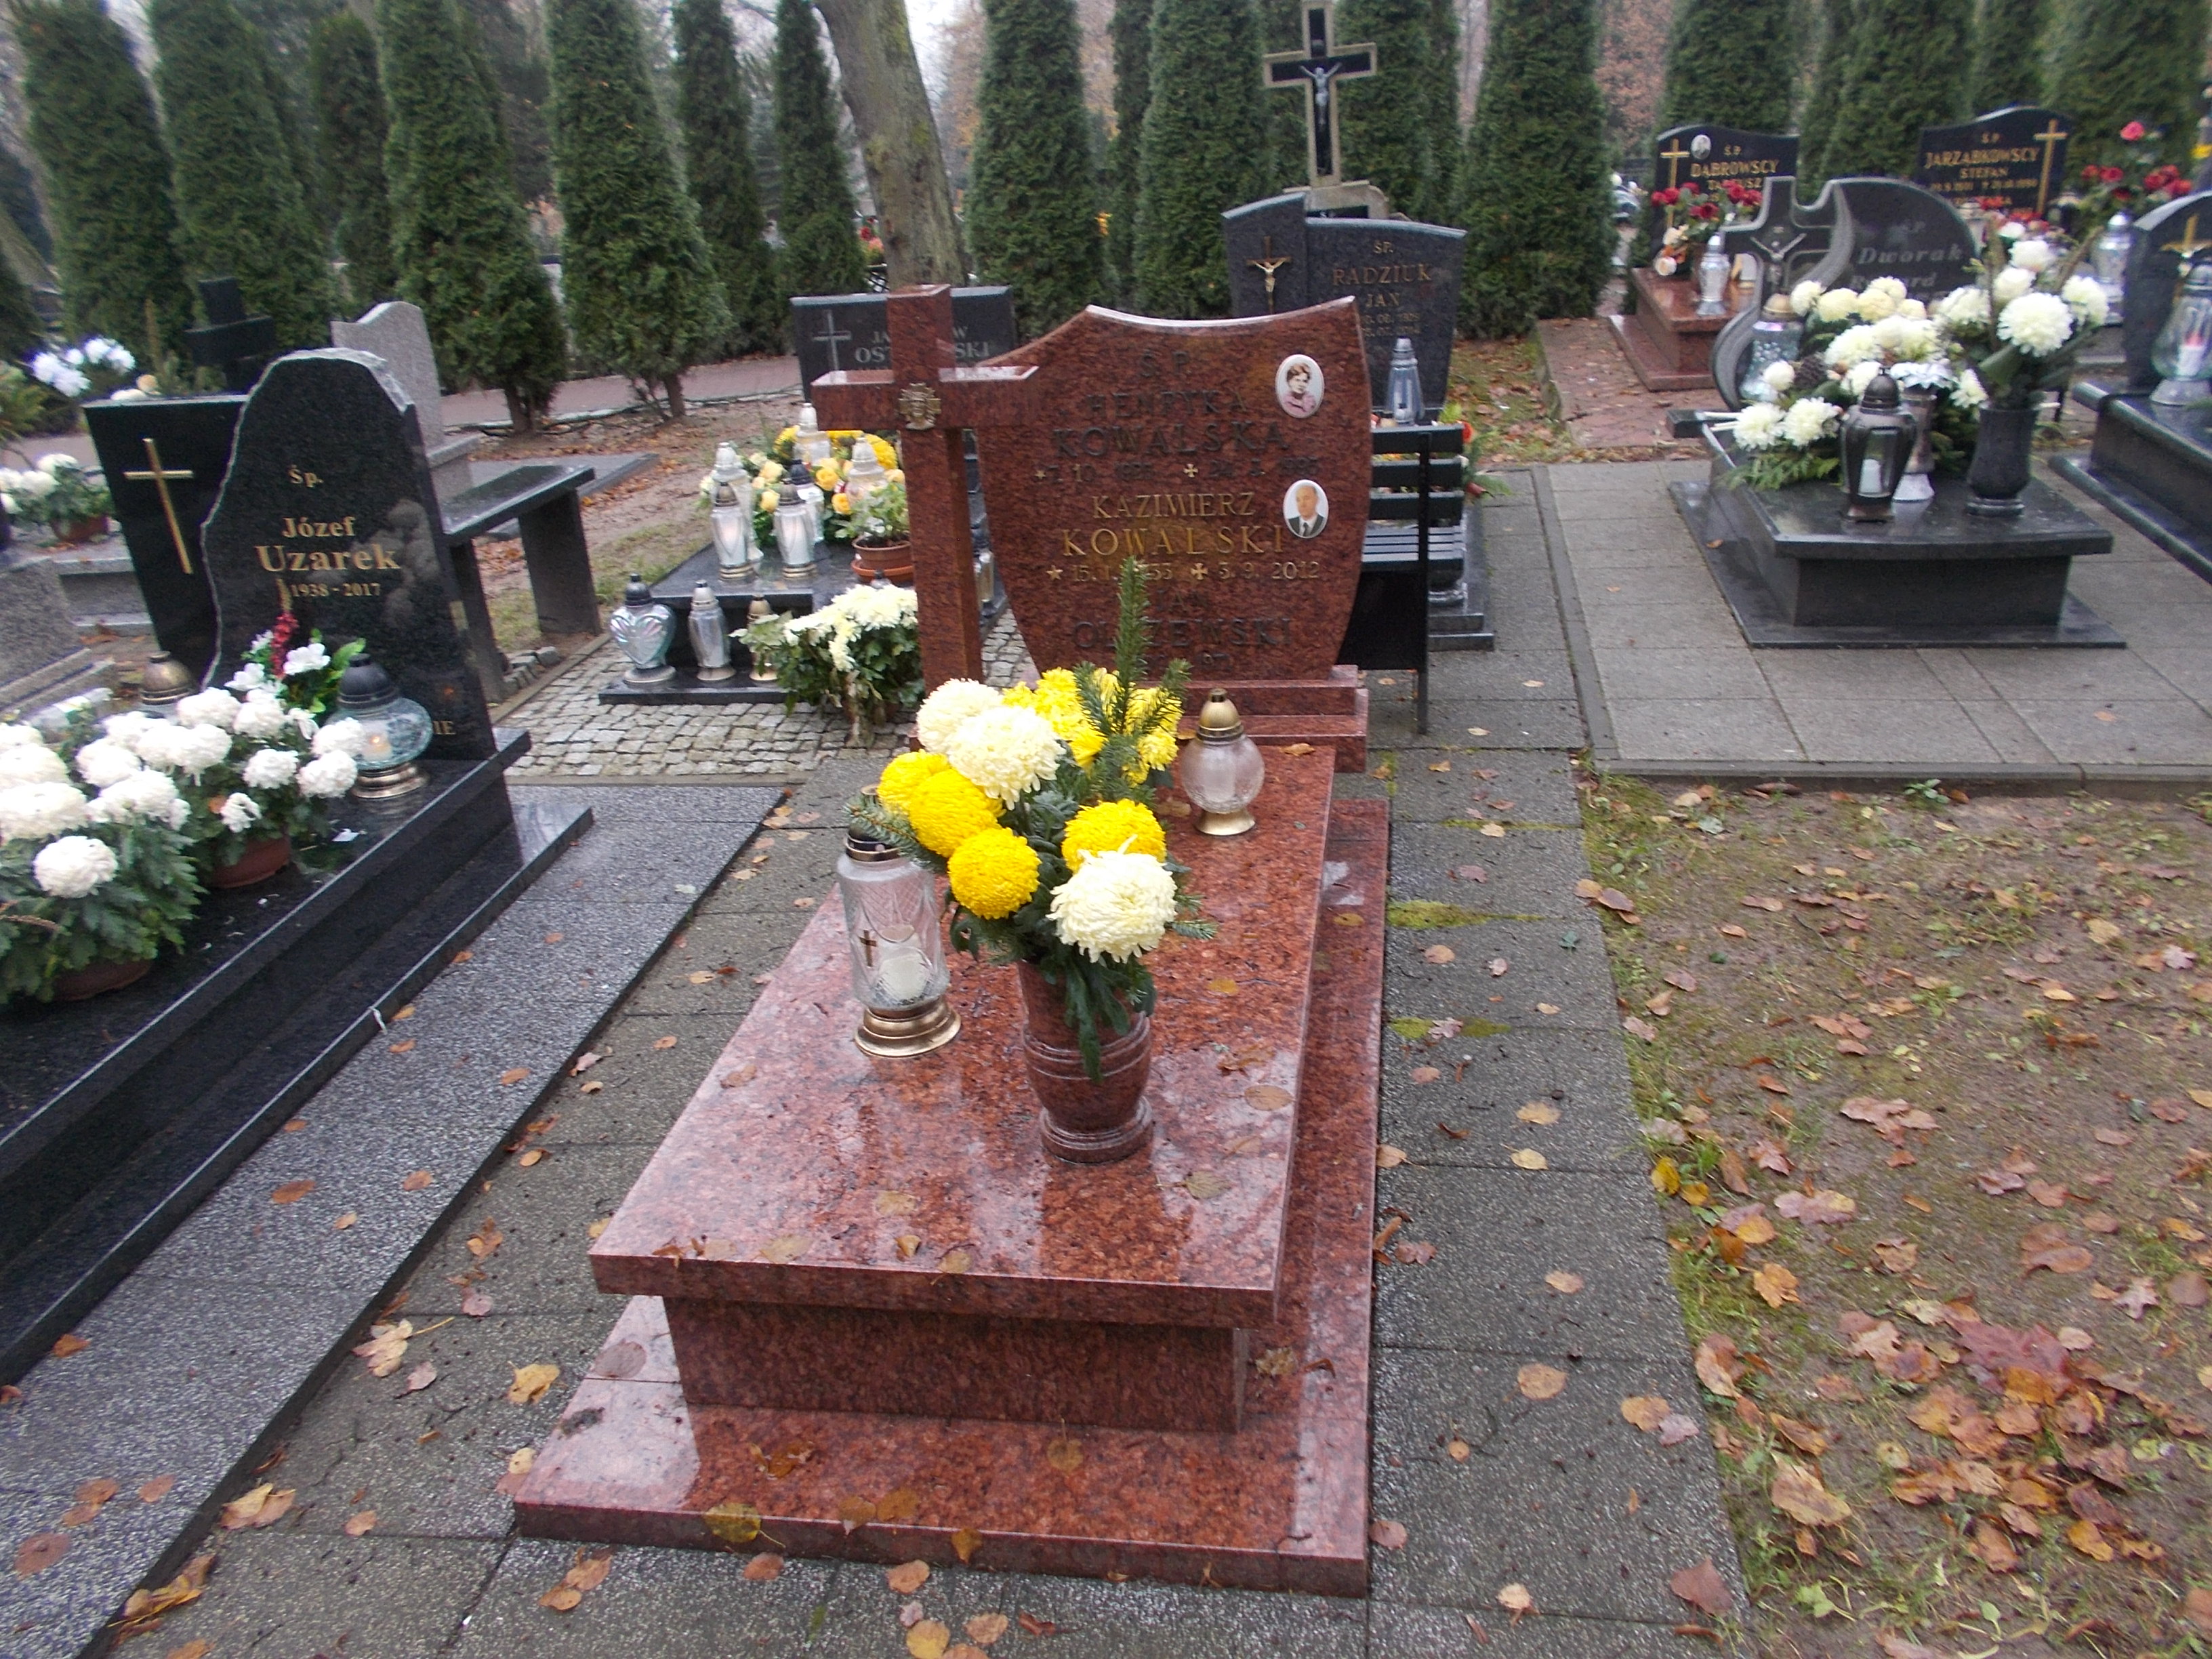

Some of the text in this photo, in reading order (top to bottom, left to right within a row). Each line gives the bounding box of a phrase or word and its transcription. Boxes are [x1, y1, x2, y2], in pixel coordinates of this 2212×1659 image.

[1333, 263, 1432, 286] RADZIUK
[1366, 293, 1400, 308] JAN
[1086, 389, 1248, 418] HENRYKA
[1053, 420, 1289, 458] KOWALSKA
[1092, 491, 1256, 520] KAZIMIERZ
[281, 516, 356, 538] Józef
[1062, 525, 1285, 556] KOWALSKI
[253, 544, 401, 573] Uzarek
[1271, 560, 1319, 581] 2012
[342, 581, 382, 597] 2017
[1073, 617, 1290, 649] OLZEWSKI
